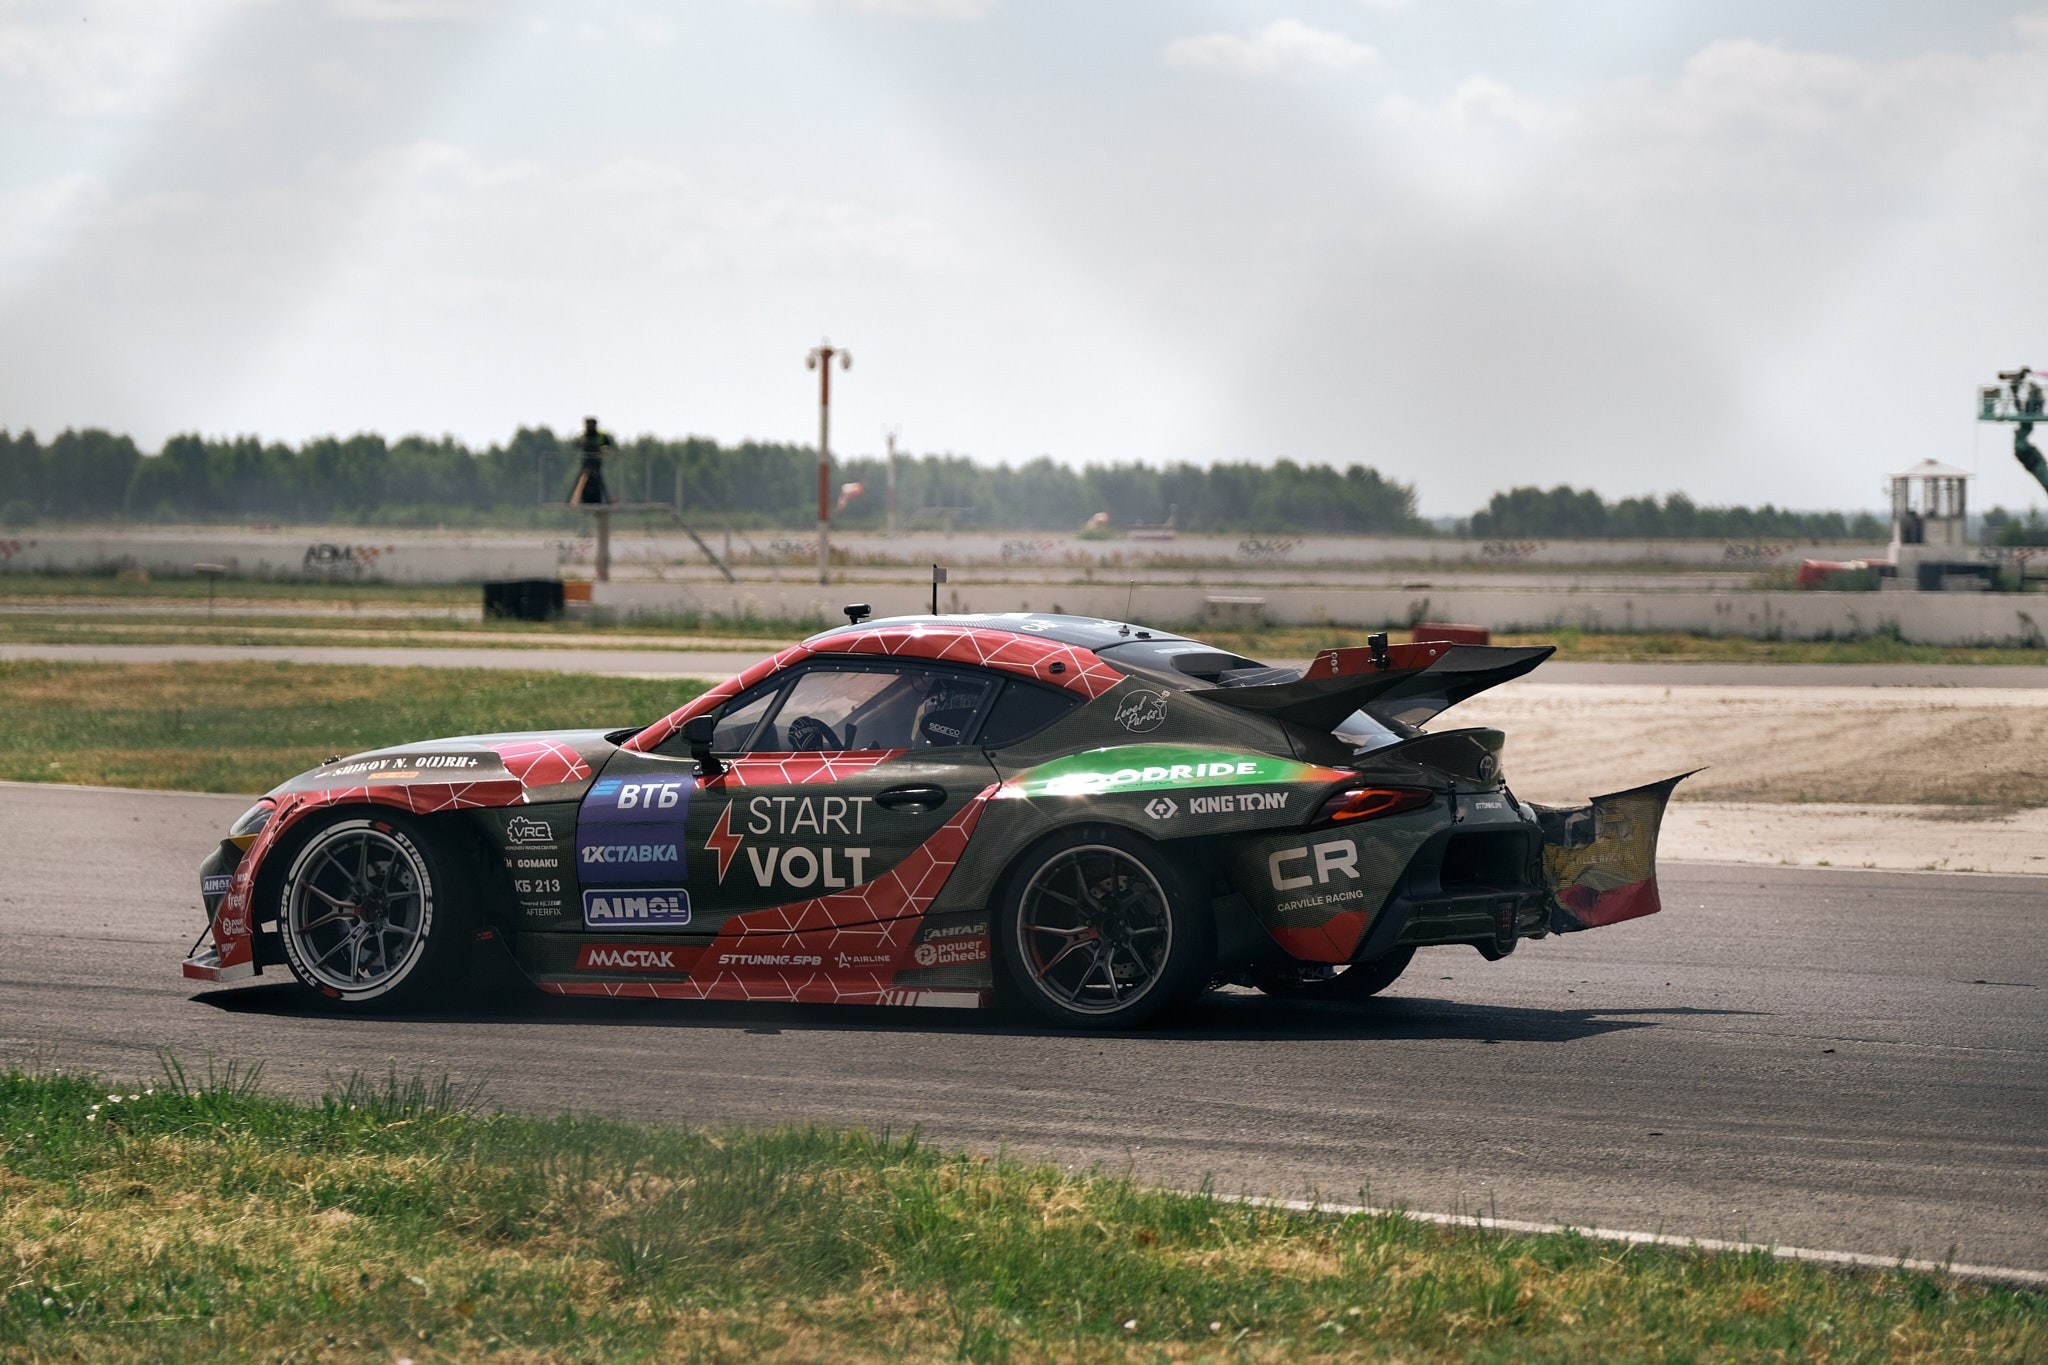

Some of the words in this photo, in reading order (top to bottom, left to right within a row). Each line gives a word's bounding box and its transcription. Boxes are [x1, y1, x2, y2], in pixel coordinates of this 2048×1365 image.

[1114, 695, 1147, 721] Level
[1126, 709, 1158, 730] Parts
[929, 722, 960, 737] sparco
[392, 757, 407, 769] N.
[1045, 762, 1257, 790] OODRIDE
[617, 782, 682, 809] ВТБ
[1190, 795, 1233, 814] KING
[1236, 792, 1290, 808] TONY
[748, 796, 873, 835] START
[514, 826, 546, 837] VRC
[517, 859, 558, 868] GOMAKU
[747, 846, 871, 888] VOLT
[1268, 838, 1361, 891] CR
[514, 879, 531, 892] КБ
[535, 879, 560, 892] 213
[588, 896, 686, 919] AIMOL
[1276, 894, 1324, 912] CARVILLE
[1325, 889, 1364, 905] RACING
[526, 908, 562, 916] AFTERFIX
[937, 941, 983, 956] power
[938, 949, 987, 963] wheels
[718, 953, 822, 966] STTUNING.SPB
[853, 954, 890, 963] AIRLINE
